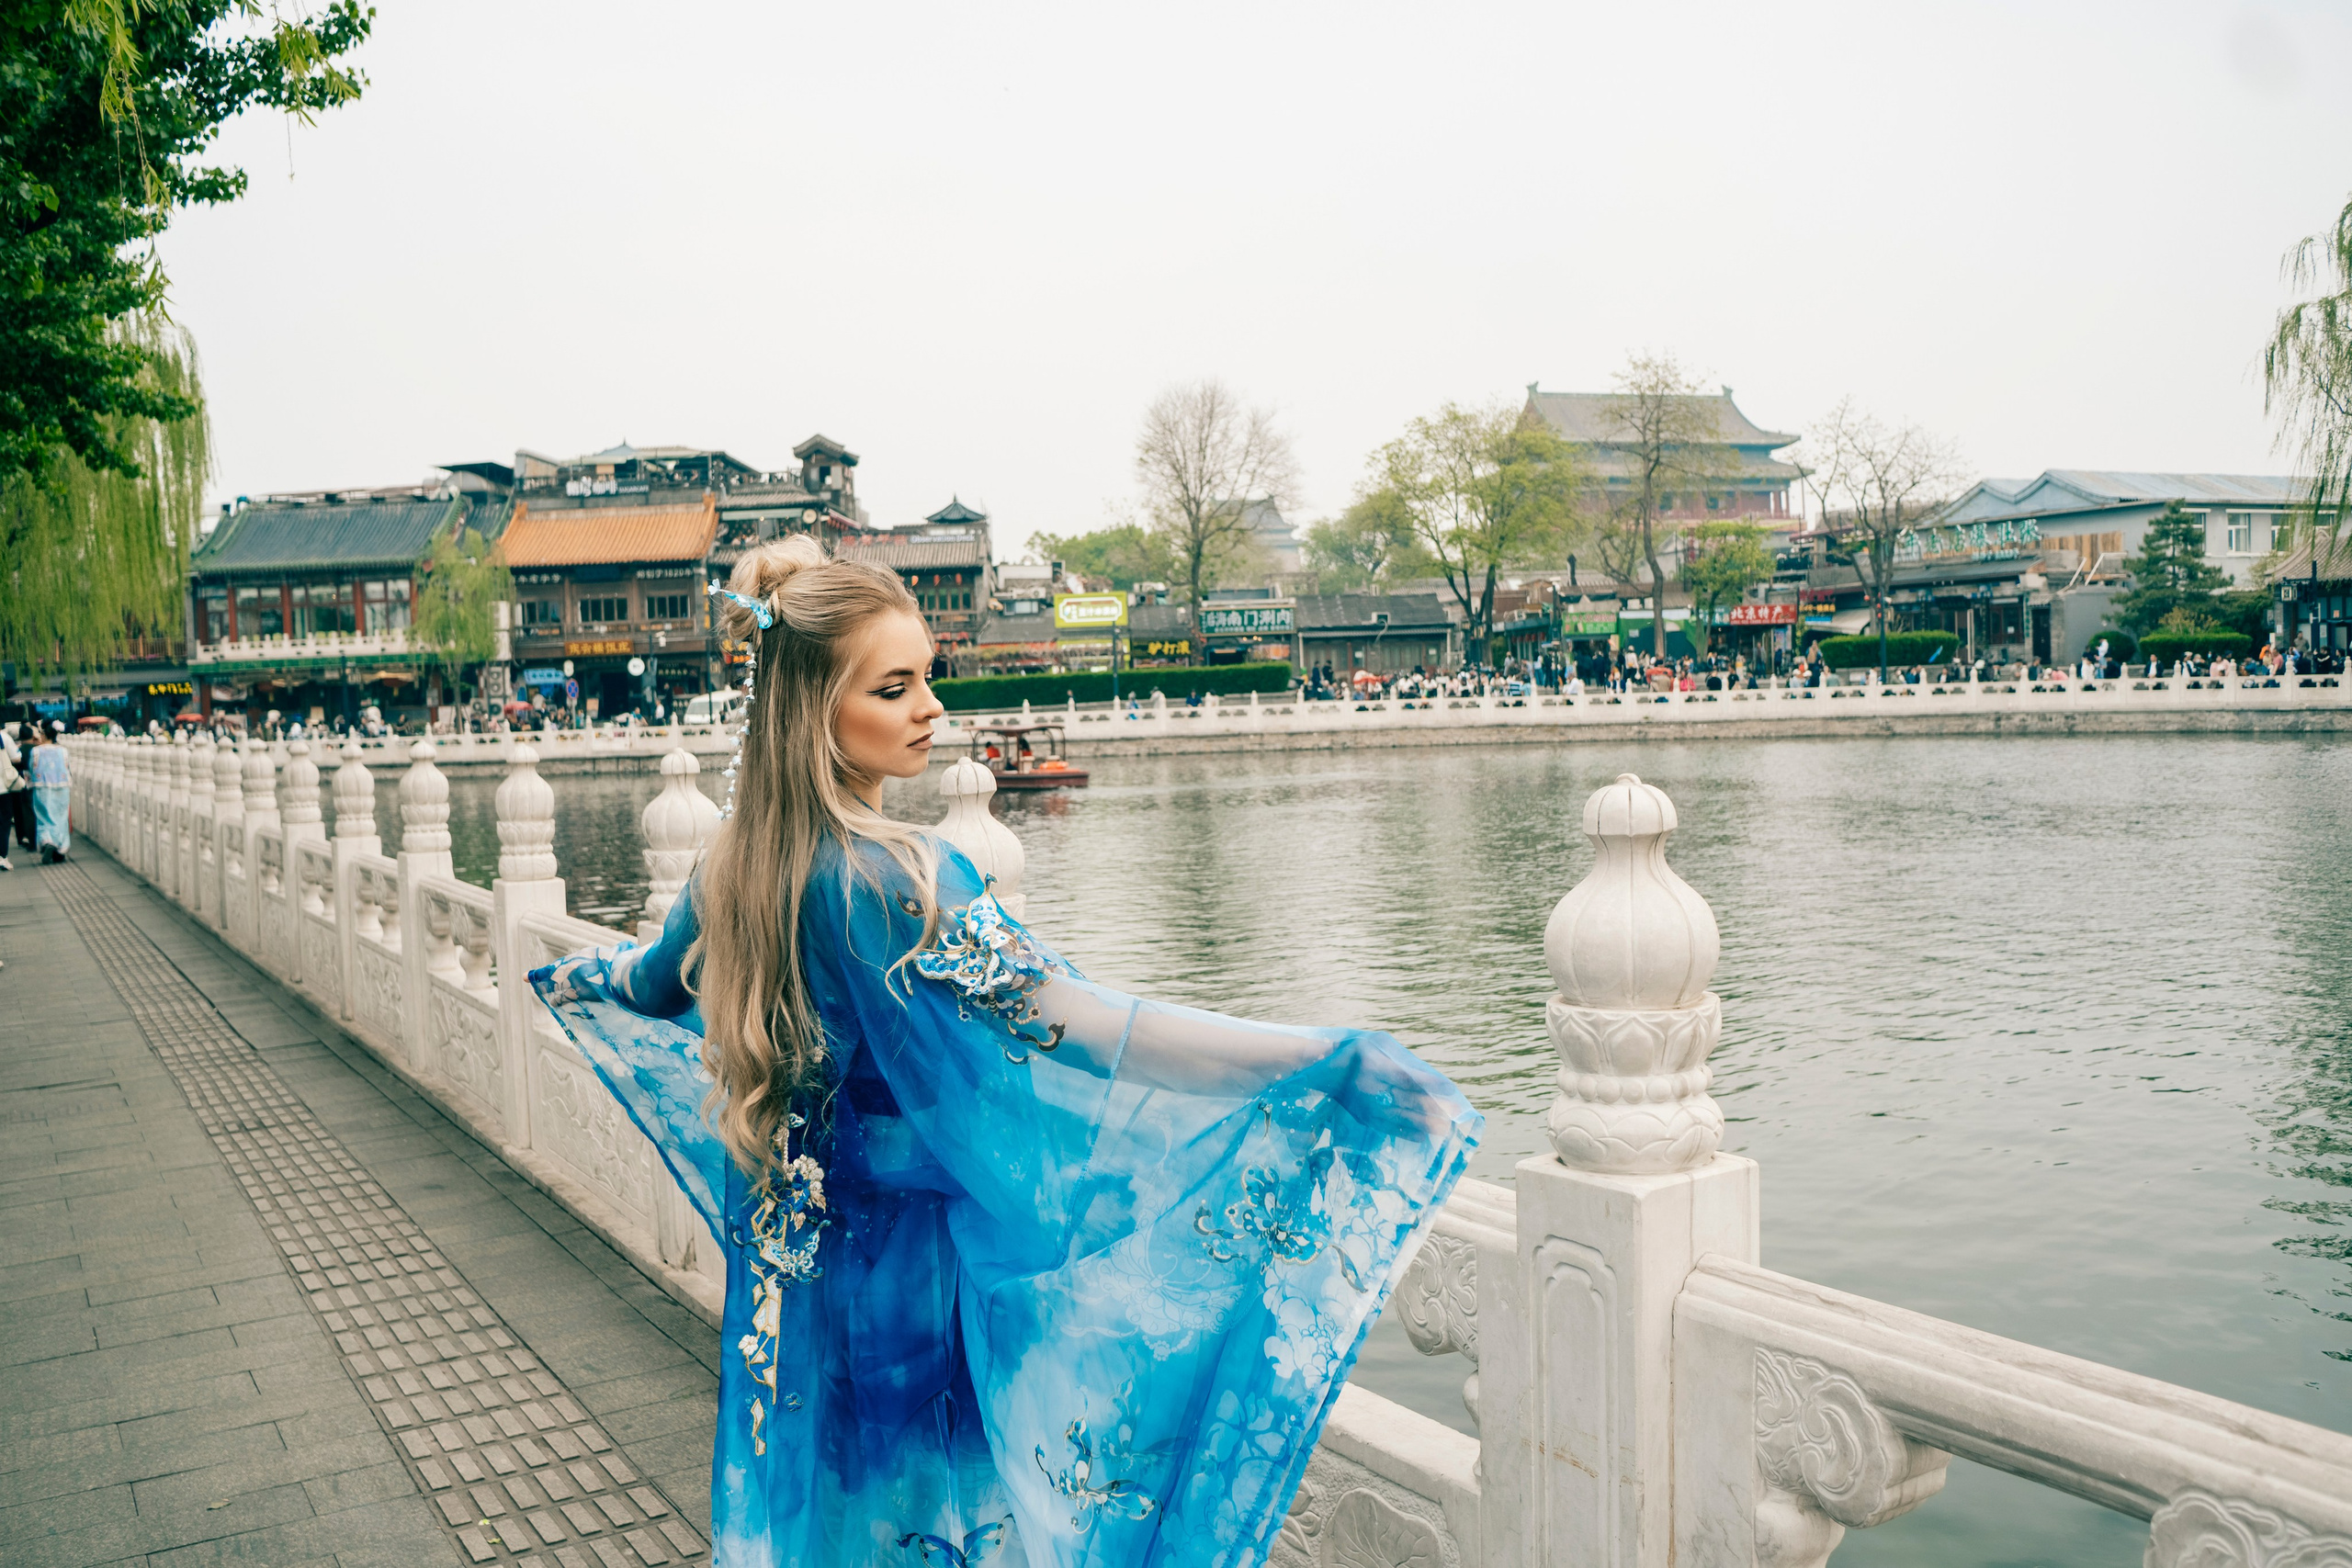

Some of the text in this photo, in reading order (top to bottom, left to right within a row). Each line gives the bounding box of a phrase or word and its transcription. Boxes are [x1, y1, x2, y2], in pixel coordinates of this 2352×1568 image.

[910, 534, 976, 544] Observation Deck
[1731, 605, 1783, 620] 北京特产
[1148, 639, 1191, 656] 驴打滚
